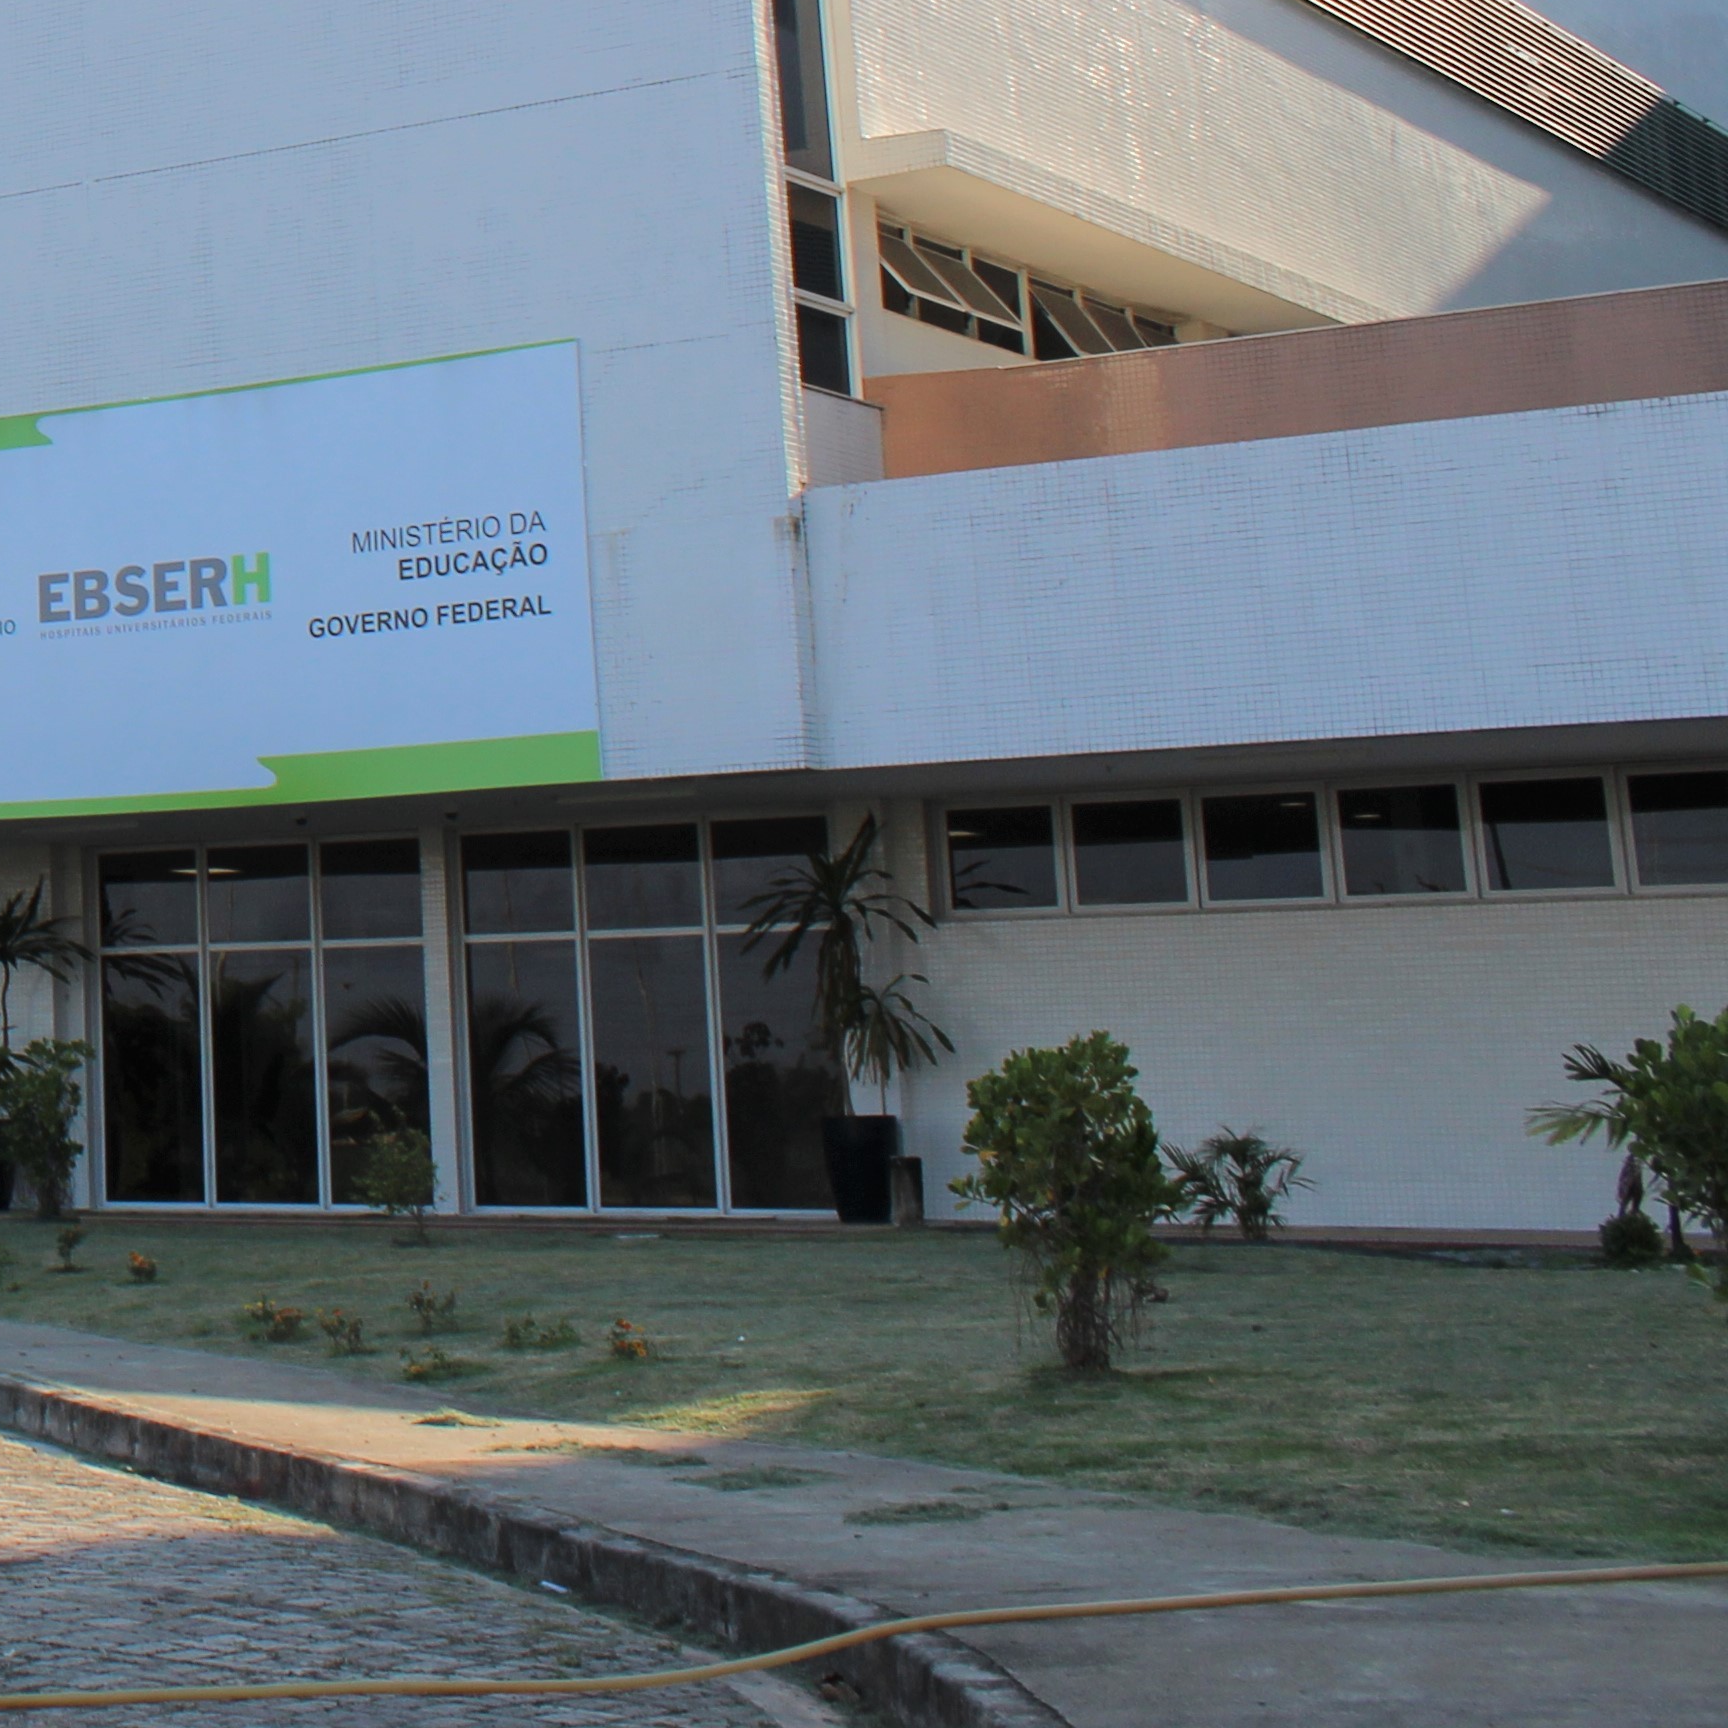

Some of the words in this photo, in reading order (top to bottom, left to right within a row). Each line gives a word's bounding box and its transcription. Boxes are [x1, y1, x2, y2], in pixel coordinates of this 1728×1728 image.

[351, 515, 501, 553] MINISTÉRIO
[509, 510, 547, 535] DA
[398, 541, 548, 580] EDUCAÇÃO
[38, 551, 271, 623] EBSERH
[40, 626, 102, 640] HOSPITAIS
[212, 610, 273, 625] FEDERAIS
[309, 607, 428, 638] GOVERNO
[436, 595, 552, 626] FEDERAL
